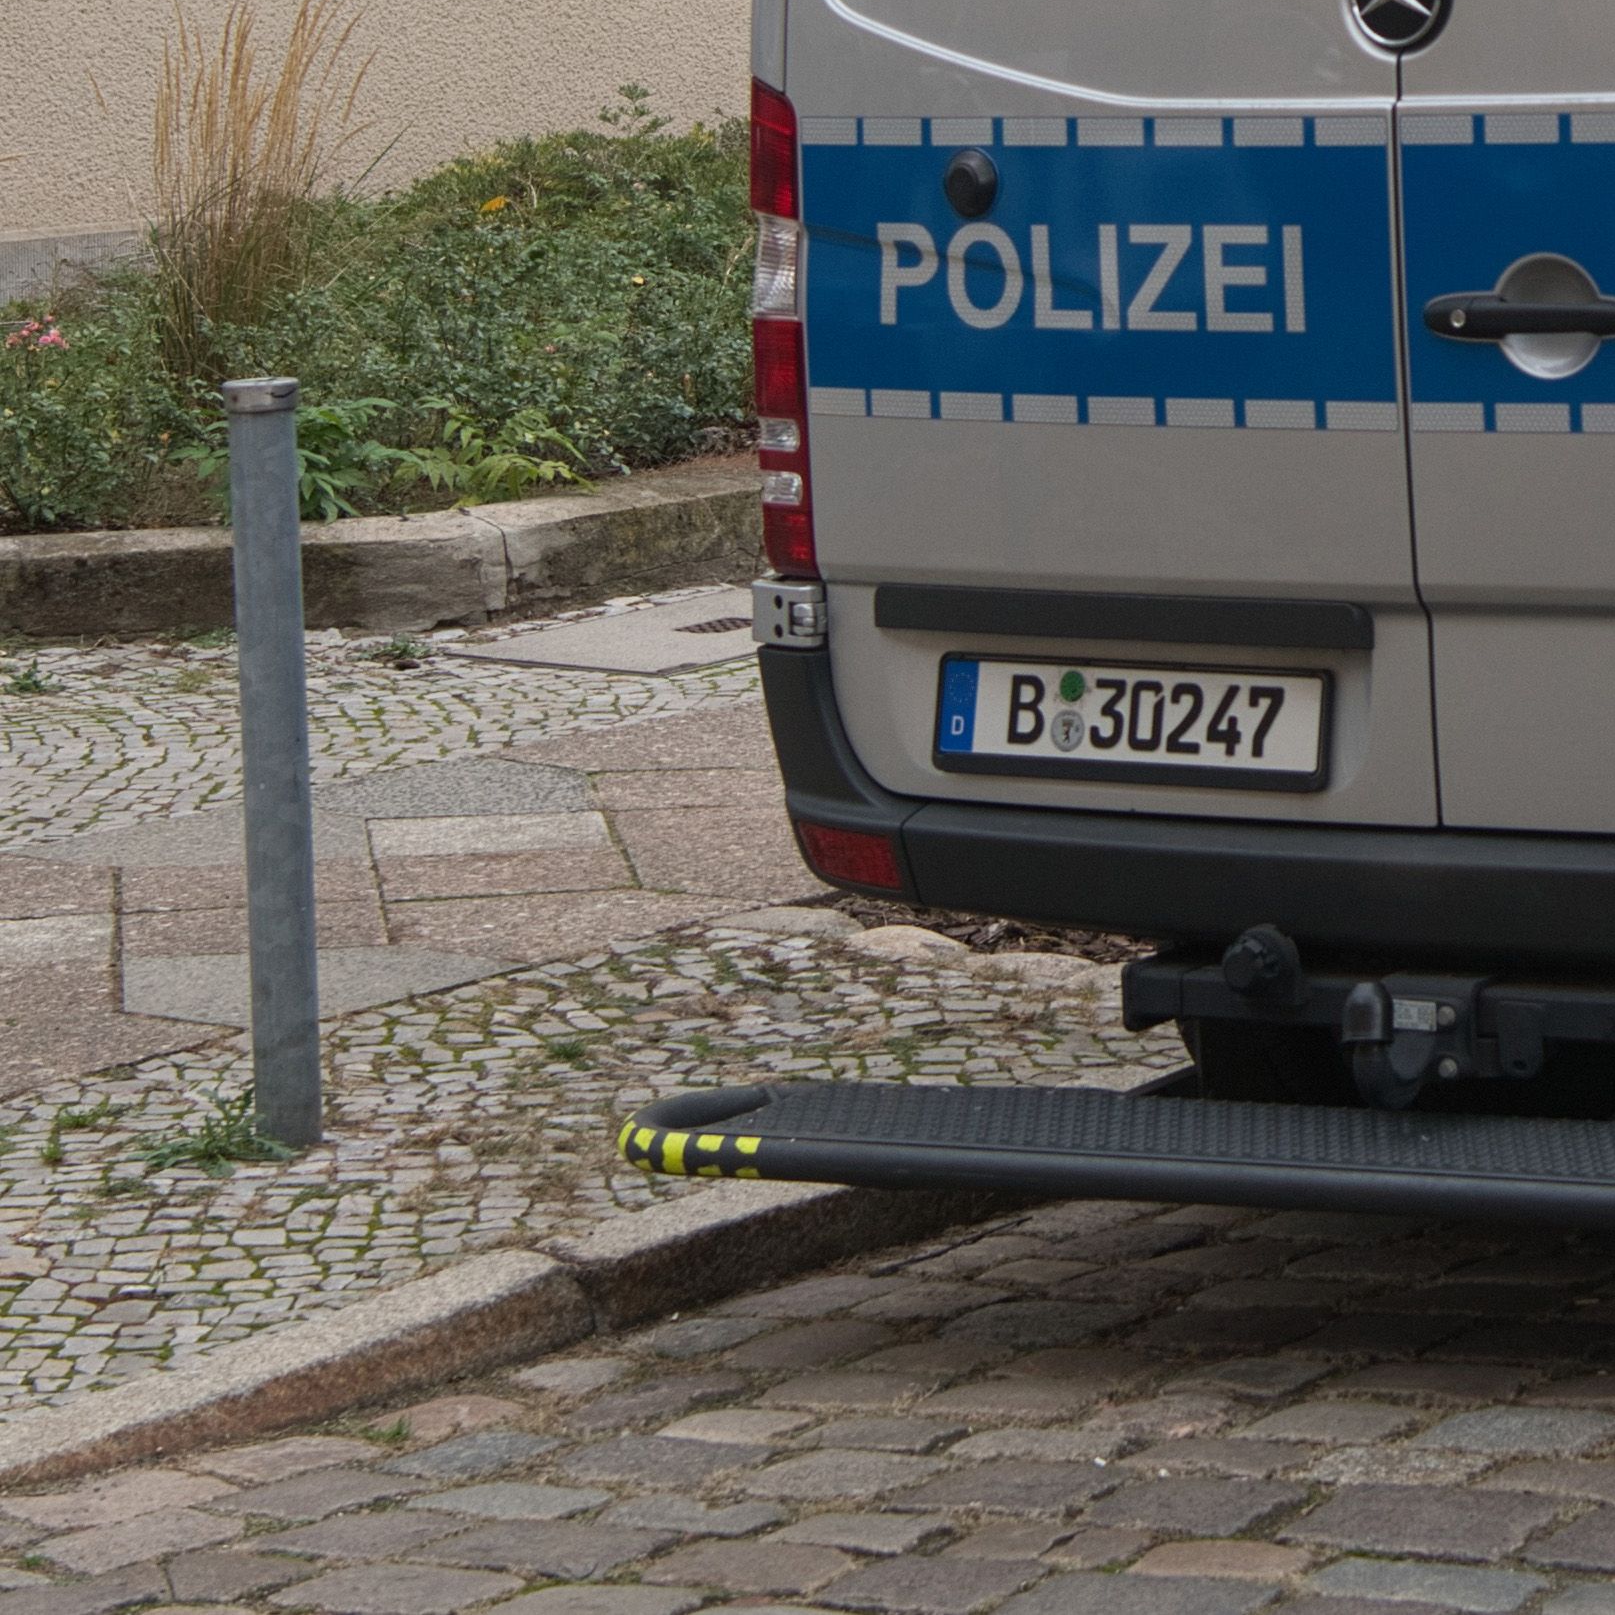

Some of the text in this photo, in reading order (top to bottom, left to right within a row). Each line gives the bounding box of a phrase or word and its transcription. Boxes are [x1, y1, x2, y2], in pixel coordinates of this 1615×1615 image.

[876, 221, 1307, 334] POLIZEI
[950, 673, 1286, 759] D B 30247
